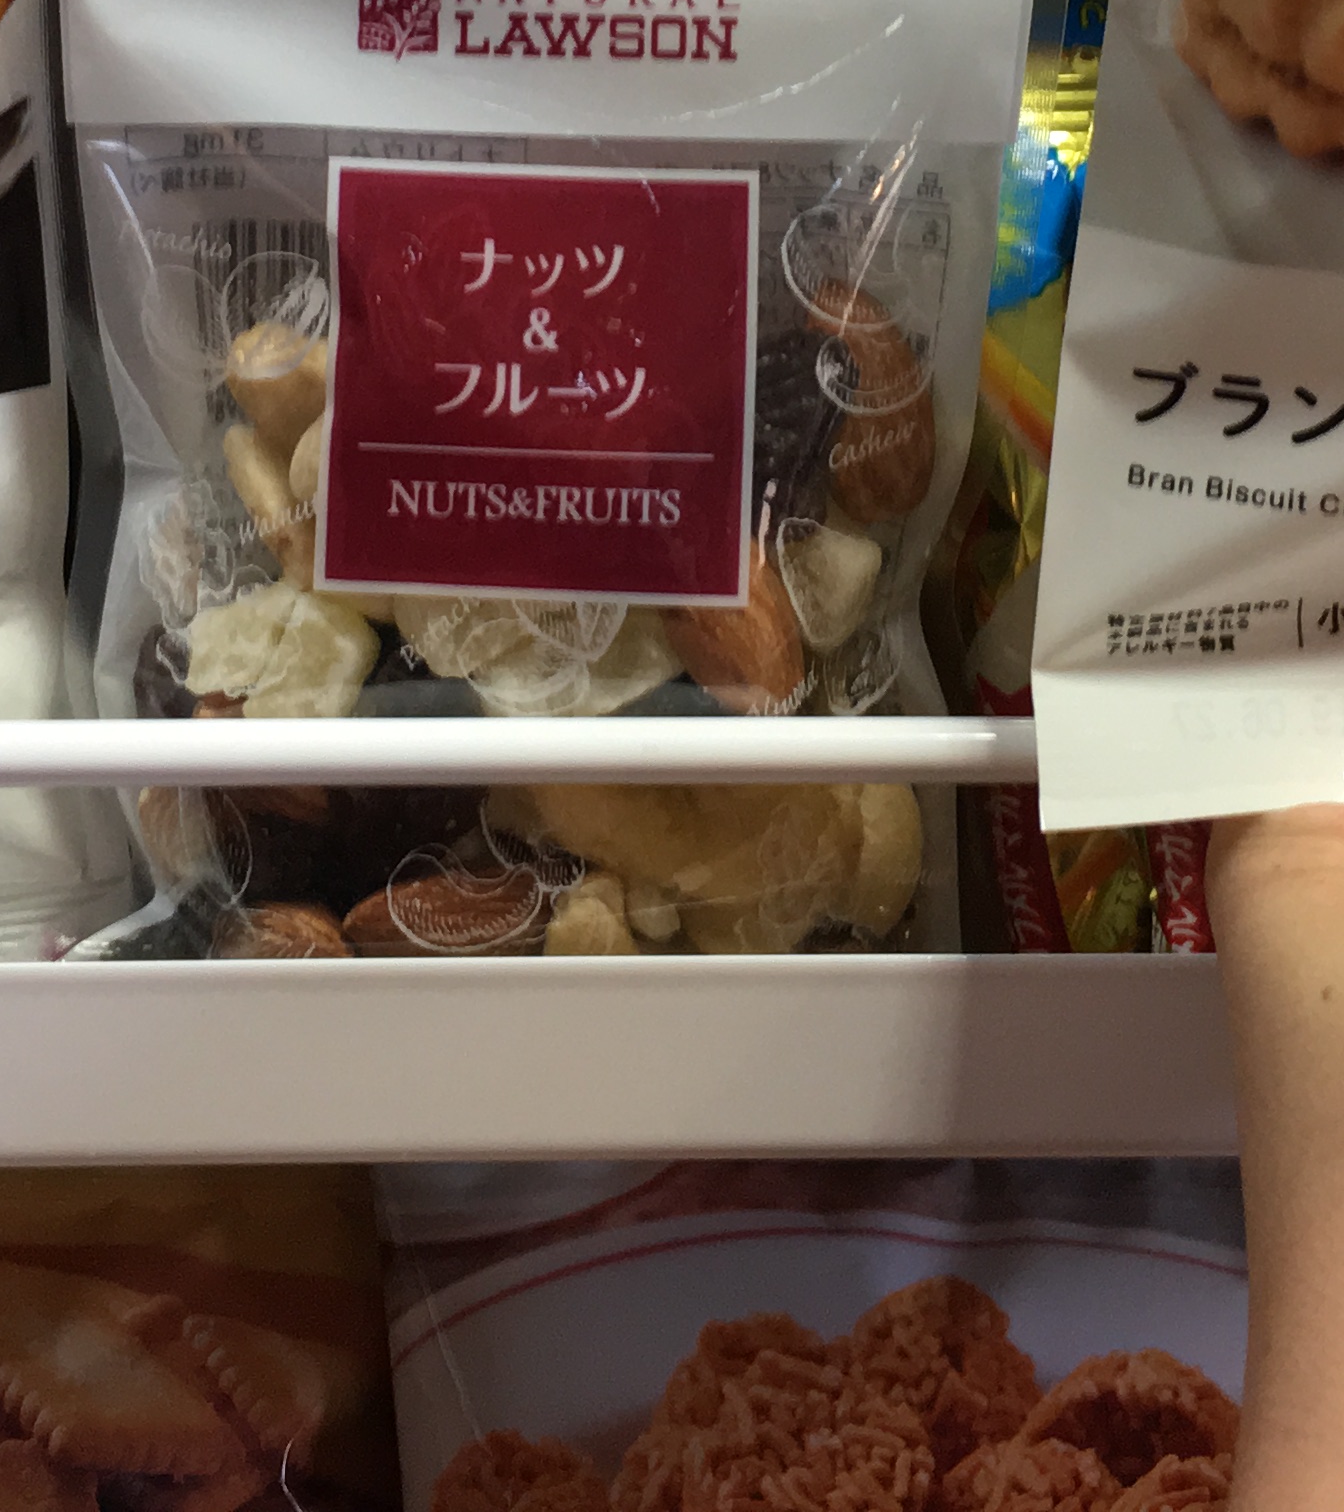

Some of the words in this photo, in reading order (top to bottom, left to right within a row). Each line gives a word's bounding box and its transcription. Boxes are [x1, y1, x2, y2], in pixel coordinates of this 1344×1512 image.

[455, 13, 739, 61] LAWSON
[460, 238, 624, 298] ナッツ
[522, 307, 559, 352] &
[434, 361, 645, 420] フルーツ
[387, 478, 682, 526] NUTS&FRUITS
[1126, 462, 1195, 497] Bran
[1205, 473, 1308, 514] Biscuit
[238, 498, 317, 546] Walnu
